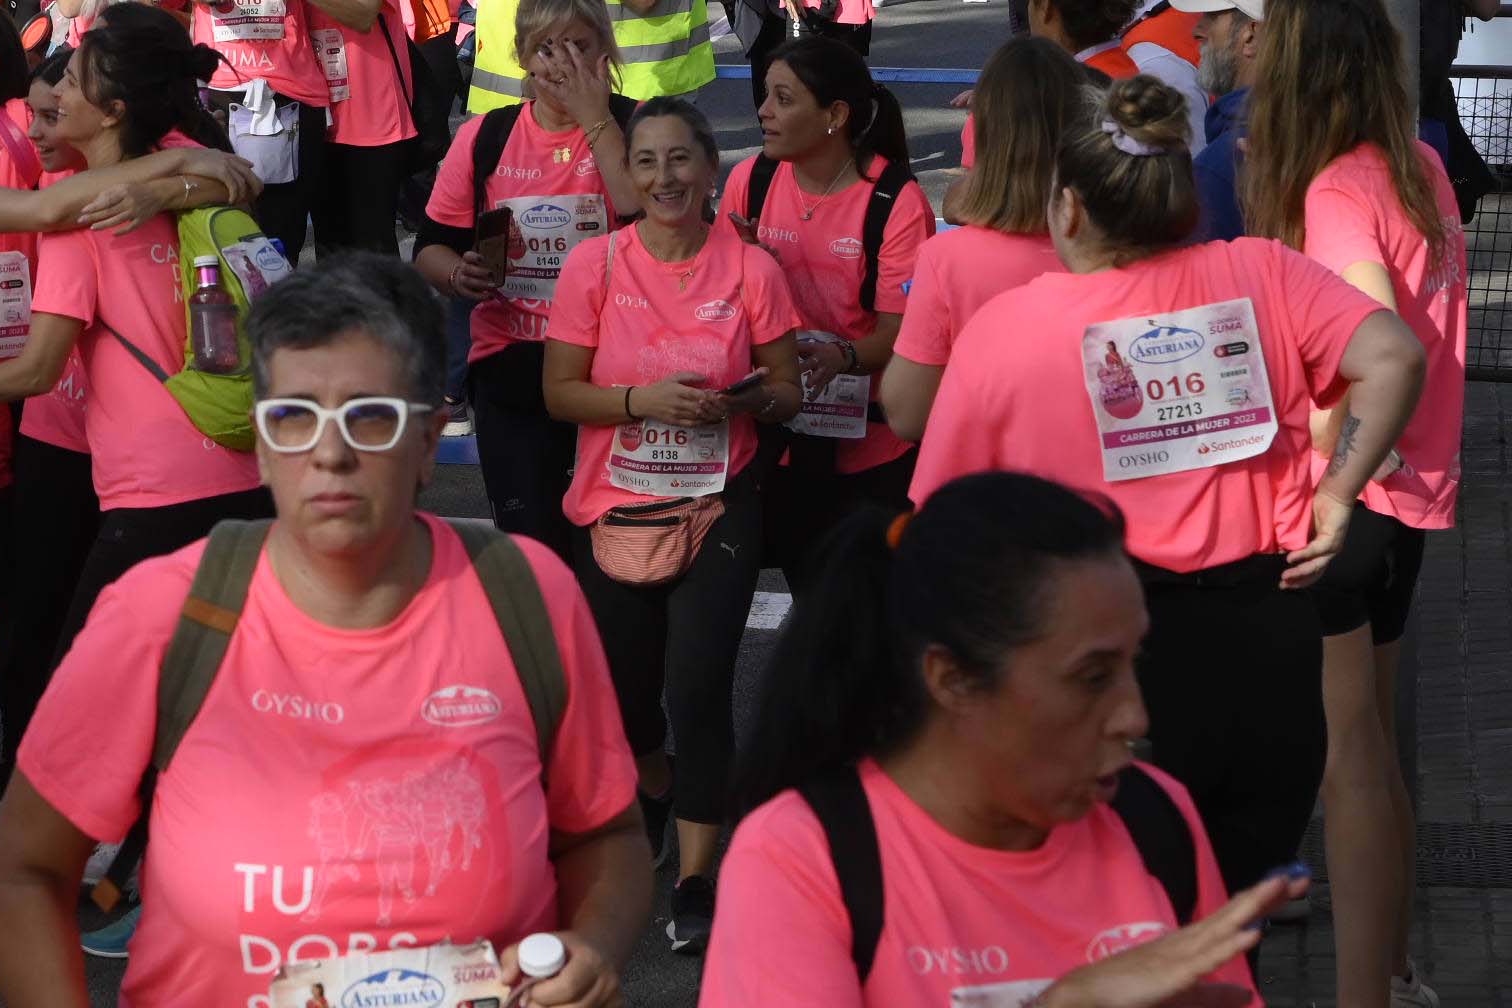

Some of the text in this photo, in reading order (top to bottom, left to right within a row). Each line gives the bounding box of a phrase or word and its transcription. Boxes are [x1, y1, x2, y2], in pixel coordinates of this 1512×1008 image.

[496, 164, 542, 181] OYSHO
[523, 212, 568, 225] ASTURIANA
[528, 237, 567, 252] 016
[1209, 321, 1243, 335] SUMA
[1136, 338, 1200, 359] ASTURIANA
[1146, 372, 1206, 401] 016
[813, 405, 836, 413] MUJER
[1157, 402, 1203, 422] 27213
[645, 429, 688, 445] 016
[1119, 413, 1257, 444] CARRERA DE LA MUJER 2023
[1210, 434, 1265, 453] Santander
[651, 449, 679, 460] 8138
[1118, 450, 1170, 469] OYSHO
[620, 459, 650, 471] CARRERA
[650, 463, 662, 472] DE
[662, 464, 673, 472] LA
[617, 473, 650, 488] OYSHO
[251, 687, 345, 725] OYSHO
[233, 863, 314, 915] TU
[453, 967, 497, 985] SUMA
[344, 982, 439, 1008] ASTURIANA
